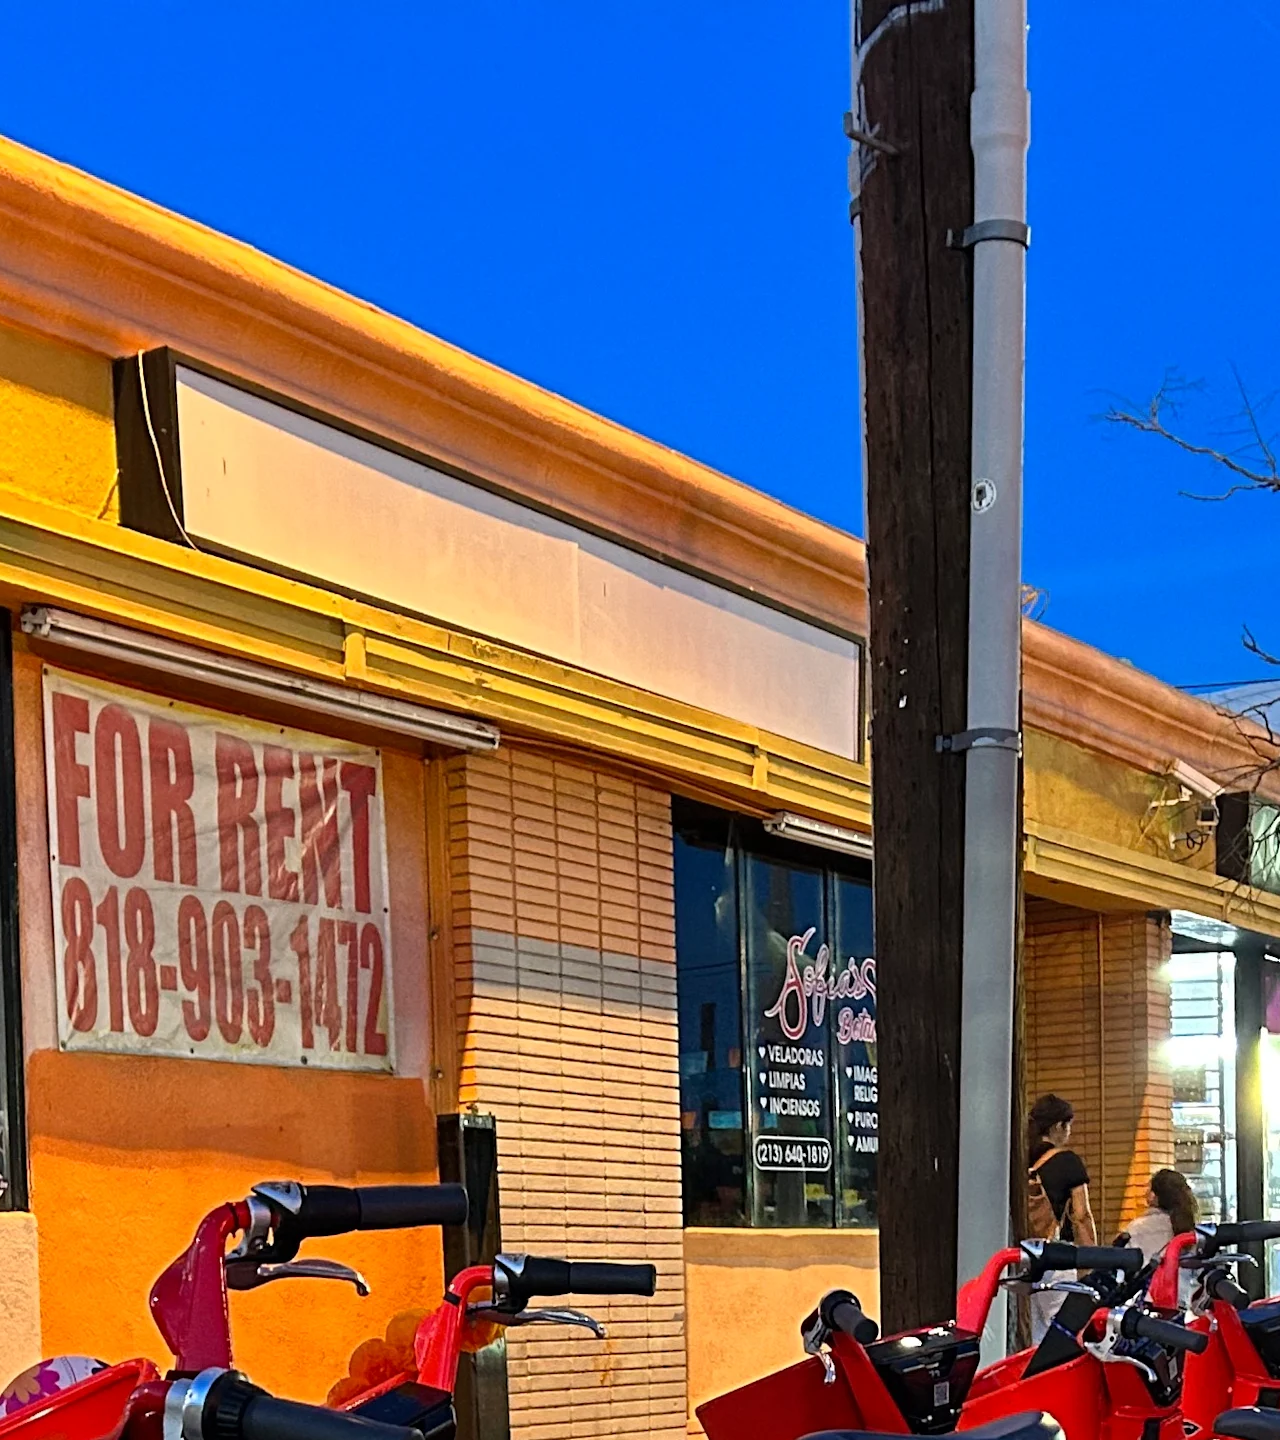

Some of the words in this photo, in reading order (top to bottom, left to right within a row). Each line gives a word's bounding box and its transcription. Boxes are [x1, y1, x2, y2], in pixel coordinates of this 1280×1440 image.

[52, 692, 198, 886] FOR
[215, 732, 376, 914] RENT
[61, 877, 387, 1055] 818-903-1472
[767, 1045, 824, 1067] VELADORAS
[768, 1071, 806, 1091] LIMPIAS
[769, 1097, 820, 1117] INCIENSOS
[757, 1144, 782, 1164] (213)
[785, 1145, 829, 1164] 640-1819
